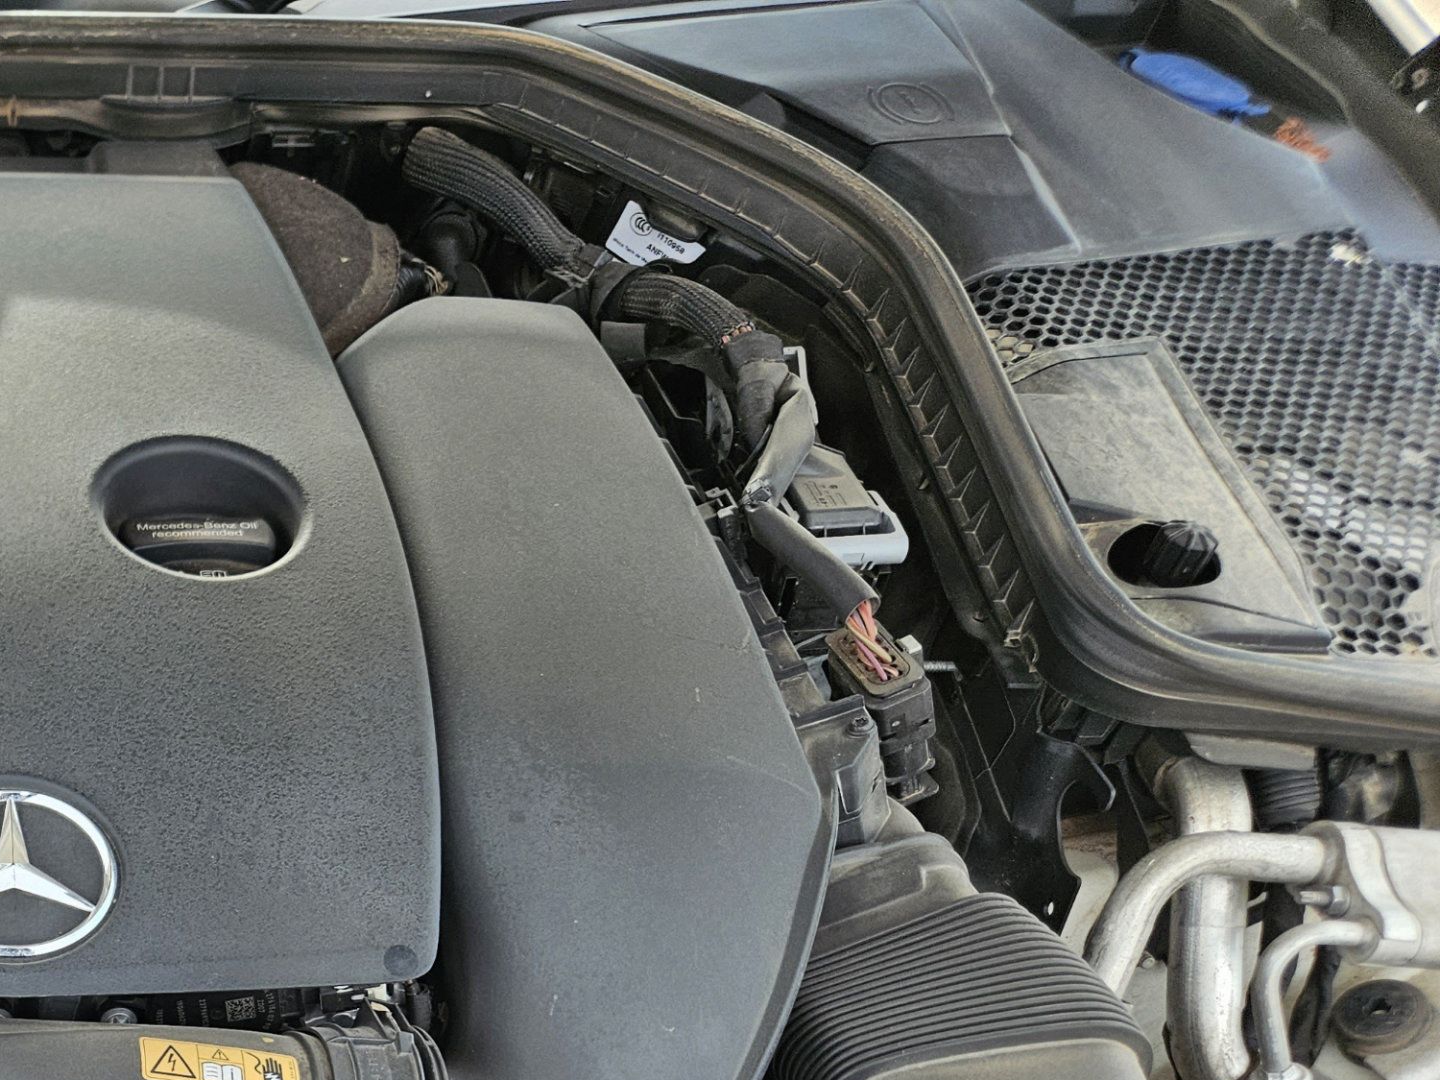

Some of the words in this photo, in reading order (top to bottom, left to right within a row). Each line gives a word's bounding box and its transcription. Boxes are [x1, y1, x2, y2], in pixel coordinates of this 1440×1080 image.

[136, 521, 237, 531] Mercedes-Benz
[239, 521, 257, 530] Oil
[151, 529, 244, 538] recommended
